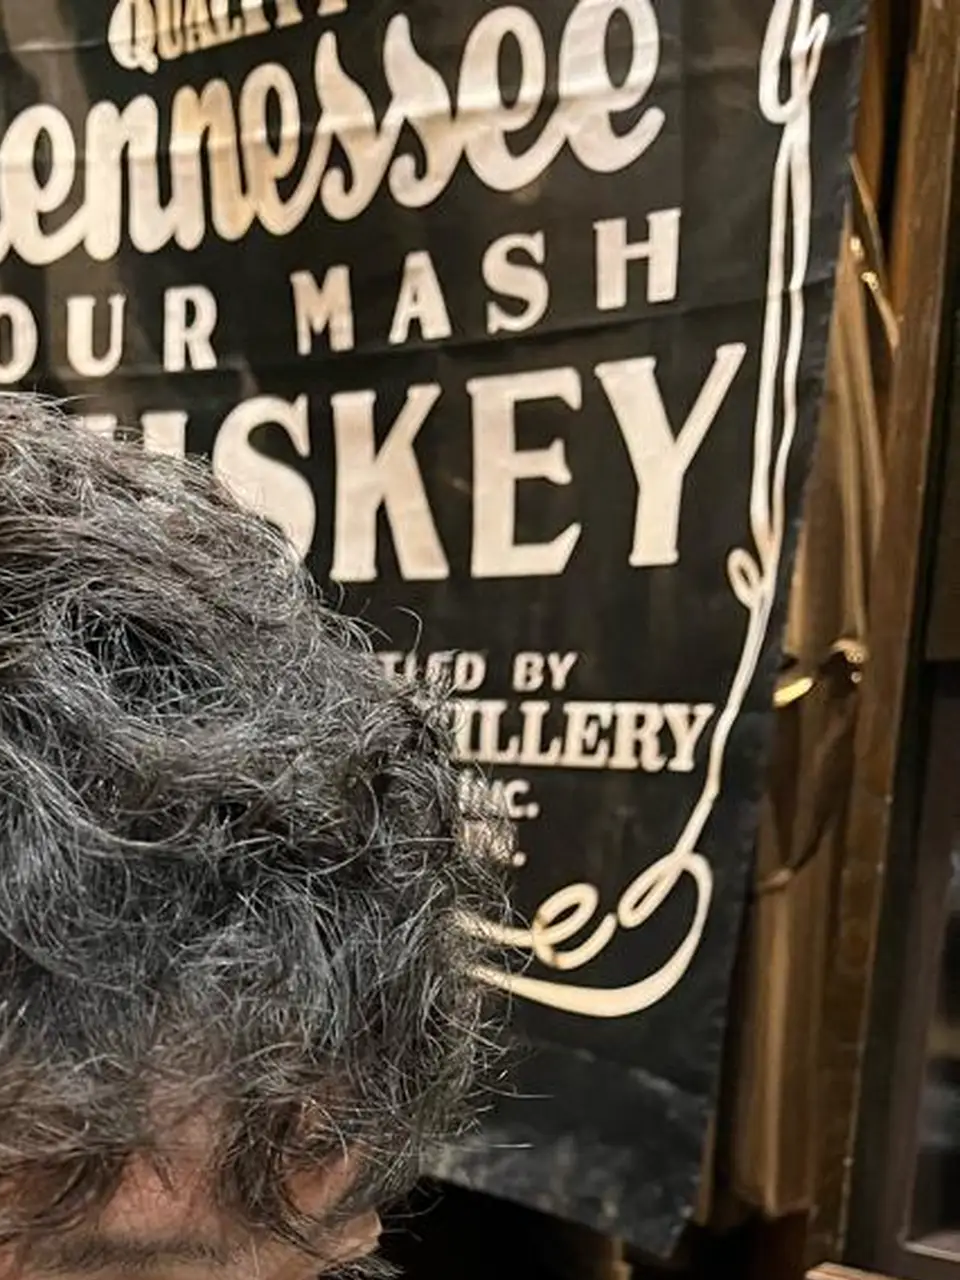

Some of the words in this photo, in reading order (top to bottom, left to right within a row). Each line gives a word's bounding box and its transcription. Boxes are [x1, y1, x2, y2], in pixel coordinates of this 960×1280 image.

[290, 207, 681, 355] MASH
[78, 342, 746, 583] SKEY
[512, 651, 578, 692] BY
[448, 699, 715, 772] ILLERY
